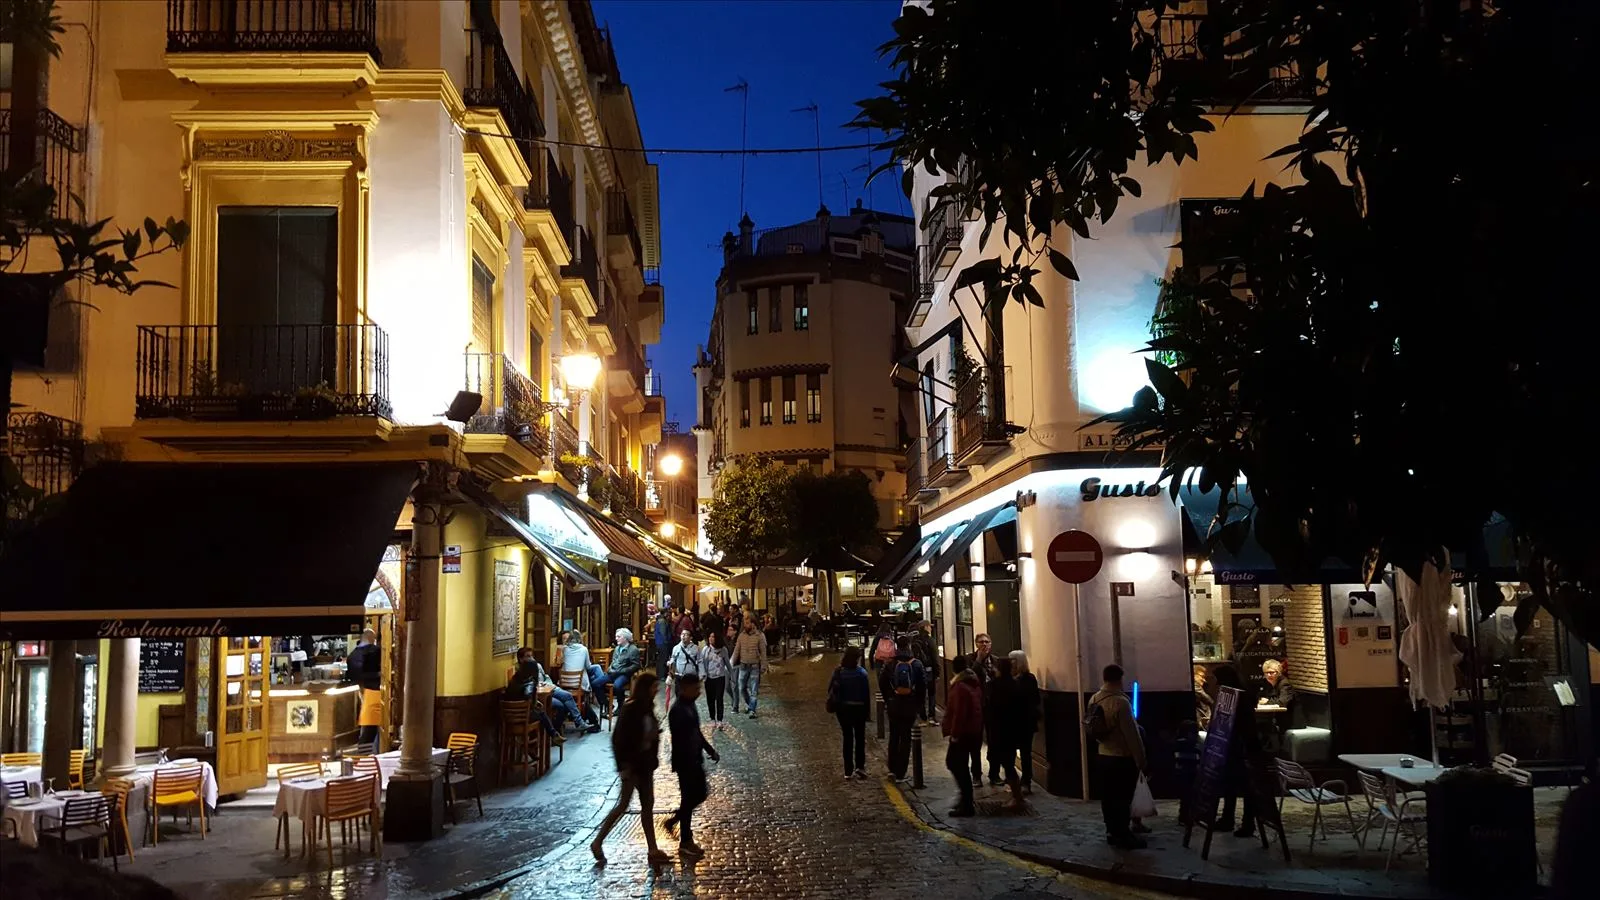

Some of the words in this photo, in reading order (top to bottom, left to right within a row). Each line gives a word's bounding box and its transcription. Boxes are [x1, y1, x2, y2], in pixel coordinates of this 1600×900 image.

[1080, 477, 1164, 501] Gusto
[1221, 570, 1255, 583] Gusto
[97, 618, 230, 637] Restaurante
